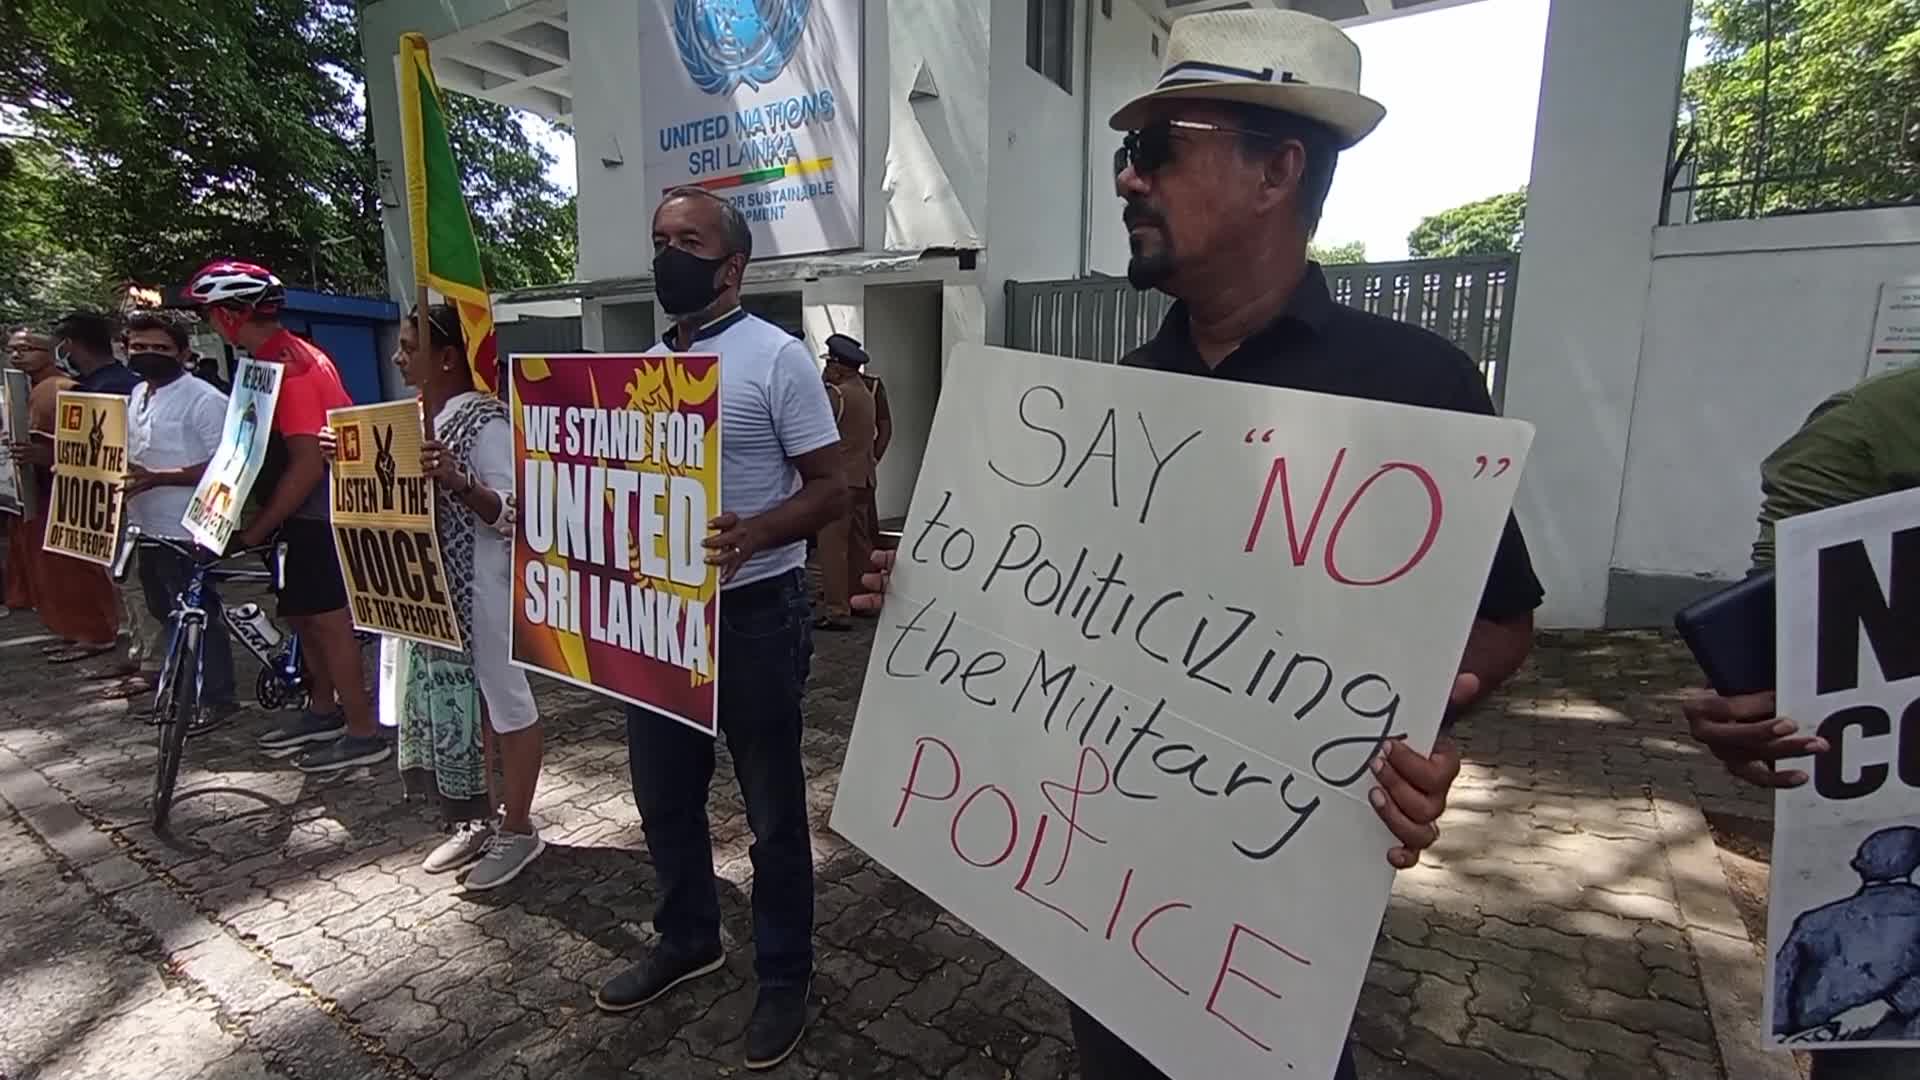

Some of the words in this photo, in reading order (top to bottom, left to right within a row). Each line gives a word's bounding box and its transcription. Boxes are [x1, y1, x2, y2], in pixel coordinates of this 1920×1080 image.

[660, 115, 729, 152] UNITED
[735, 90, 835, 138] NATIONS
[689, 147, 720, 175] SRI
[727, 133, 801, 170] LANKA
[741, 206, 785, 223] PMENT
[747, 181, 834, 206] SUSTAINABLE
[57, 440, 88, 467] LISTEN
[102, 445, 124, 472] THE
[523, 404, 560, 453] WE
[565, 407, 645, 461] STAND
[652, 411, 705, 468] FOR
[988, 386, 1202, 524] SAY
[57, 475, 119, 534] VOICE
[335, 477, 379, 514] LISTEN
[398, 477, 429, 515] THE
[524, 458, 709, 587] UNITED
[51, 524, 64, 546] OF
[65, 527, 79, 551] THE
[80, 530, 114, 559] PEOPLE
[912, 492, 975, 571] to
[338, 528, 446, 605] VOICE
[354, 594, 375, 625] OF
[375, 598, 402, 631] THE
[401, 603, 456, 641] PEOPLE
[525, 560, 580, 634] SRI
[590, 574, 709, 676] LANKA
[1817, 526, 1920, 696] N
[885, 598, 1005, 706] the
[1012, 649, 1320, 859] Military
